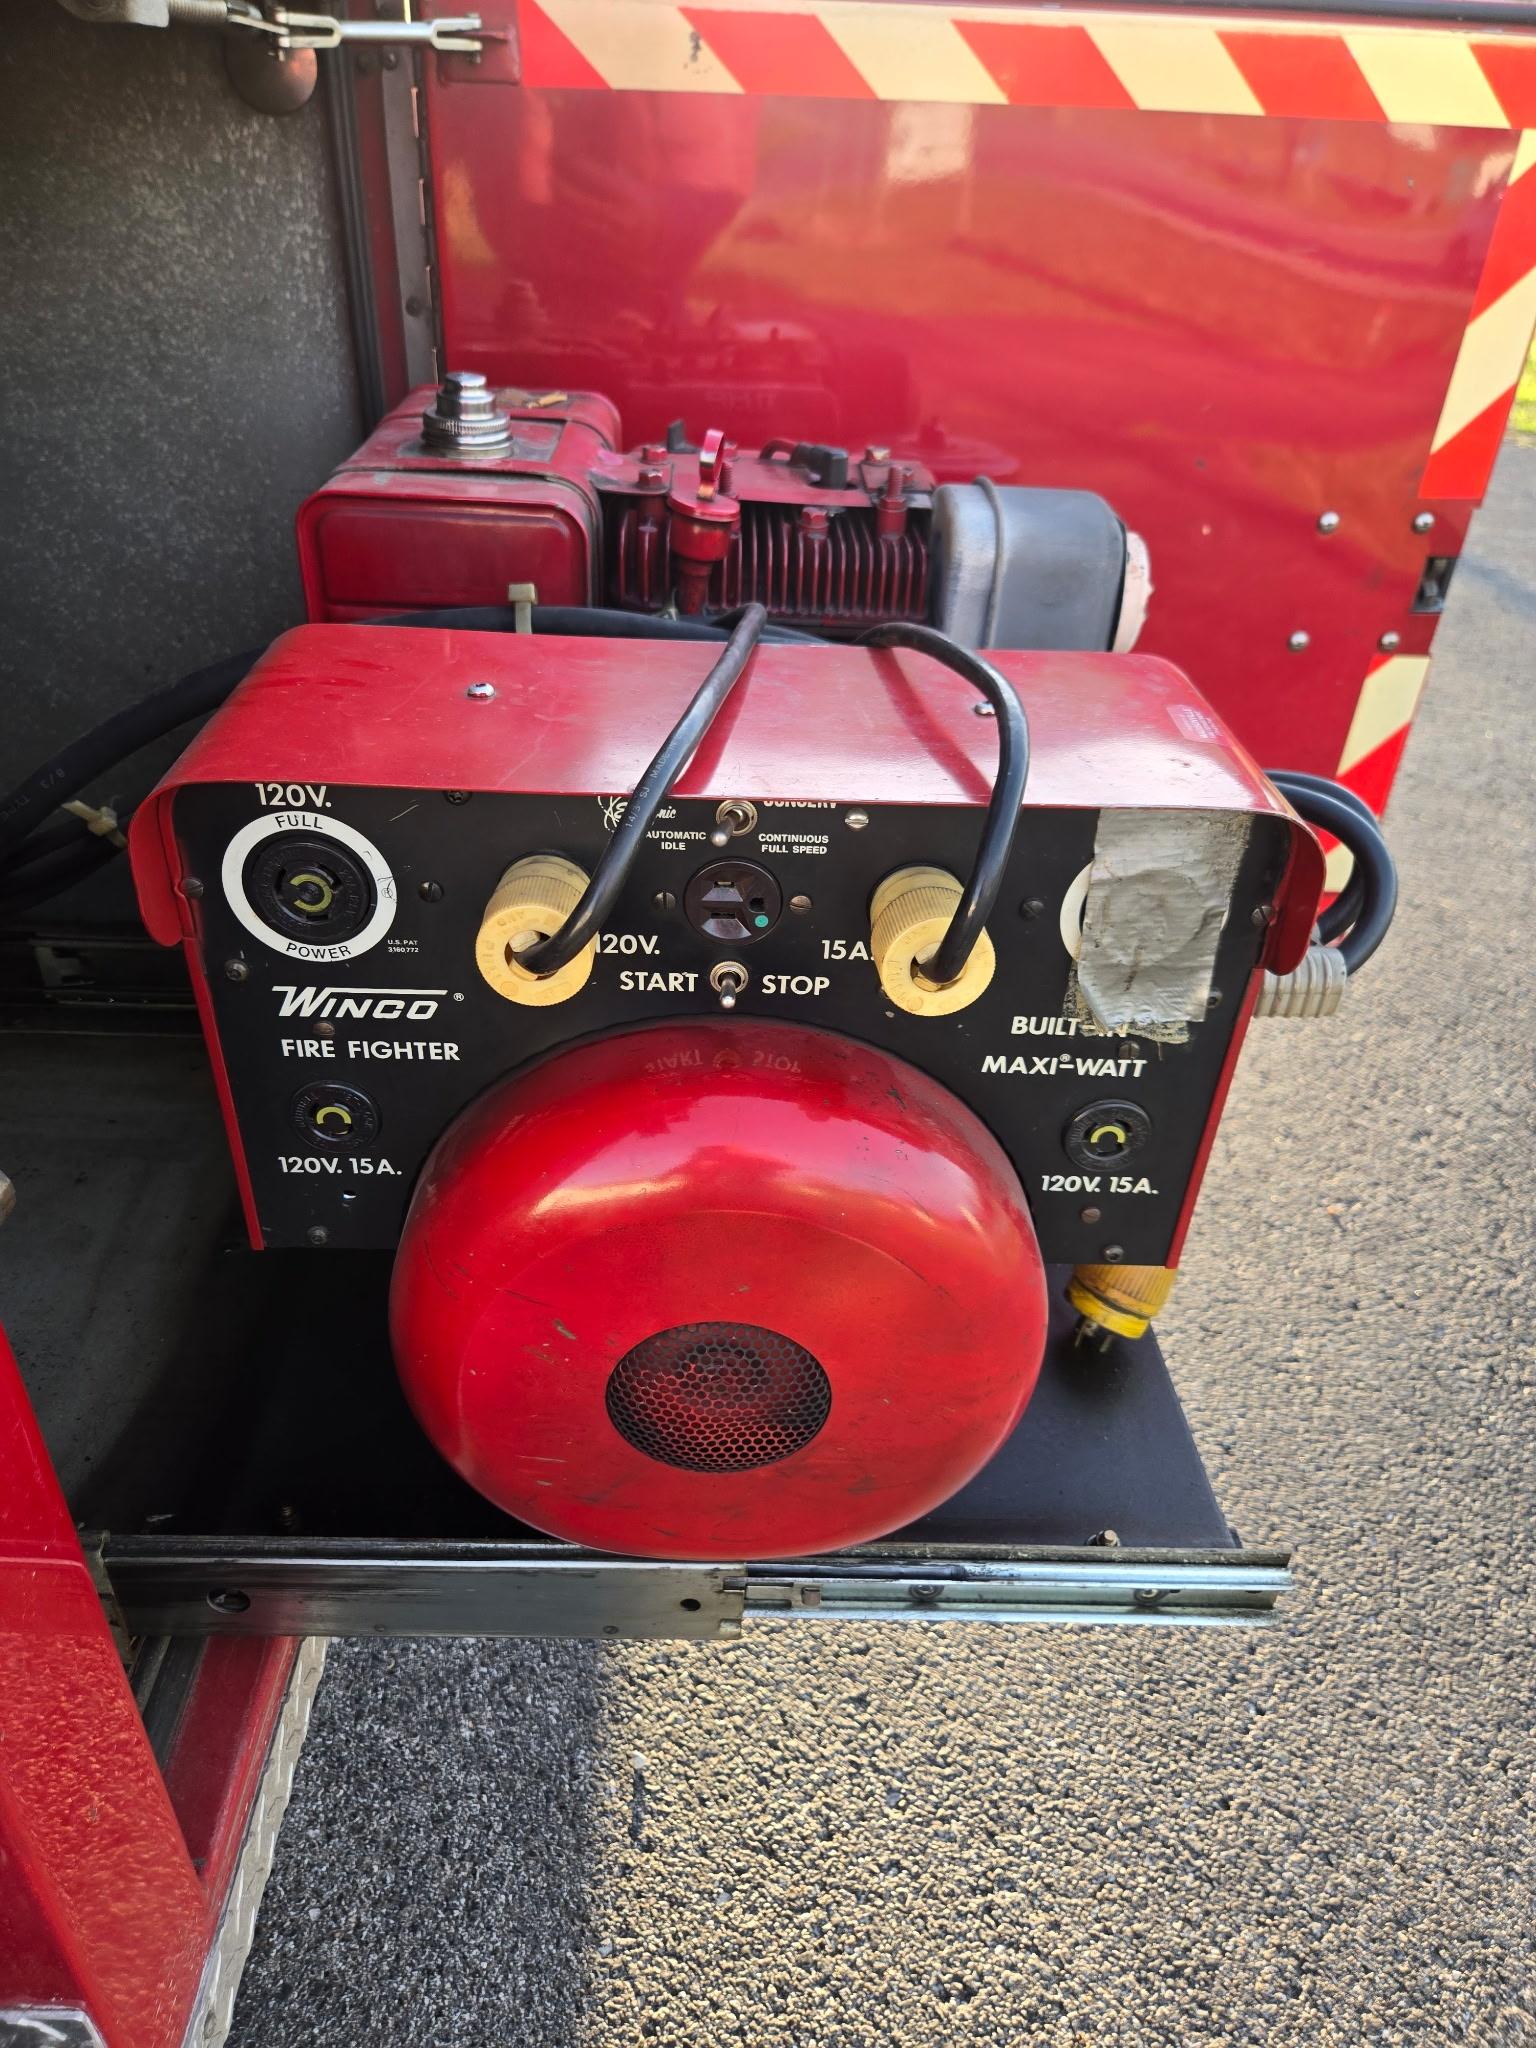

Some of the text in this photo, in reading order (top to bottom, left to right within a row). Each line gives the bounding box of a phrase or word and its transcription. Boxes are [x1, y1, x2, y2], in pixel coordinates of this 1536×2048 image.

[255, 783, 332, 808] 120V.
[275, 814, 324, 830] FULL
[646, 831, 707, 840] AUTOMATIC
[758, 833, 829, 843] CONTINUOUS
[661, 841, 686, 850] IDLE
[761, 844, 827, 855] FULL SPEED
[285, 942, 352, 959] POWER
[619, 971, 830, 995] START STOP
[271, 985, 448, 1020] WINCO
[281, 1039, 461, 1061] FIRE FIGHTER
[278, 1156, 403, 1176] 120V. 15A.
[1041, 1175, 1159, 1195] 120V. 15A.
